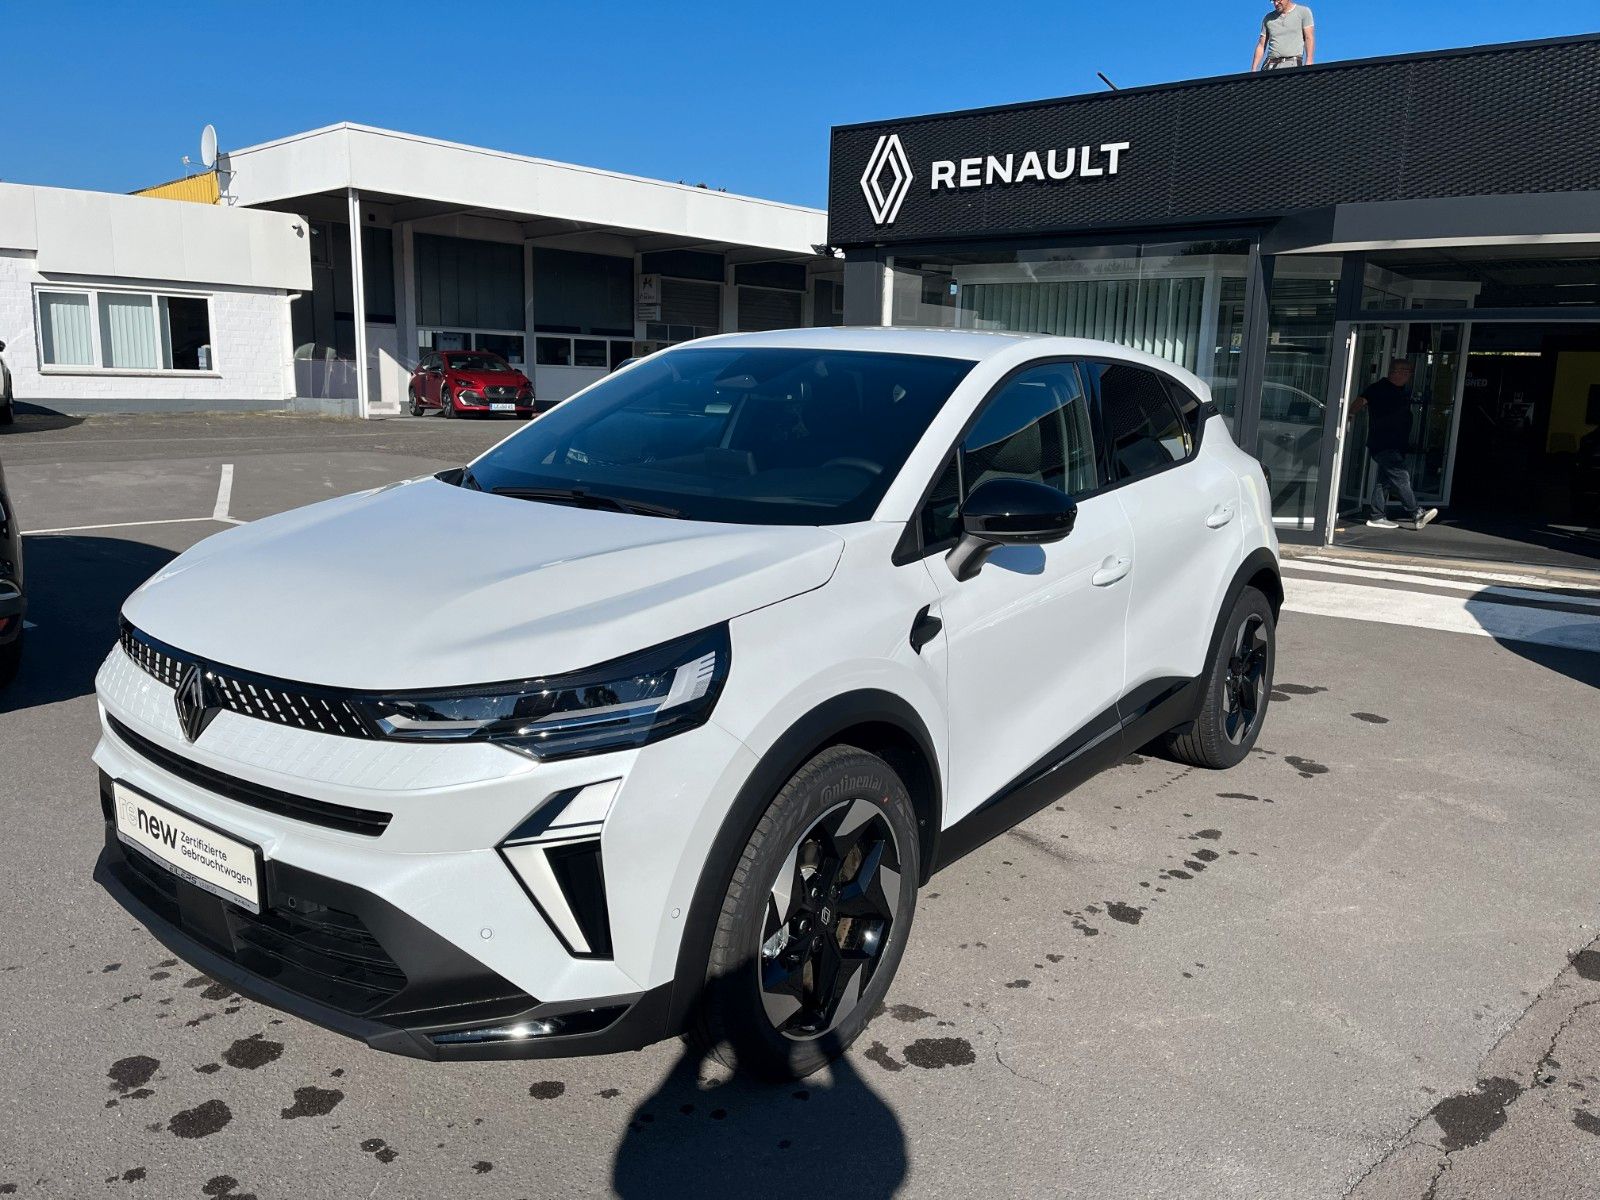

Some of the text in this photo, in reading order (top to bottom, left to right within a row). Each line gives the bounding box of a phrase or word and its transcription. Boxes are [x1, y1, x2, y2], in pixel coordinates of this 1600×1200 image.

[931, 142, 1130, 190] RENAULT
[821, 774, 882, 804] Continental
[180, 831, 228, 862] Zertifizierte
[181, 846, 252, 887] Gebrauchtwagen
